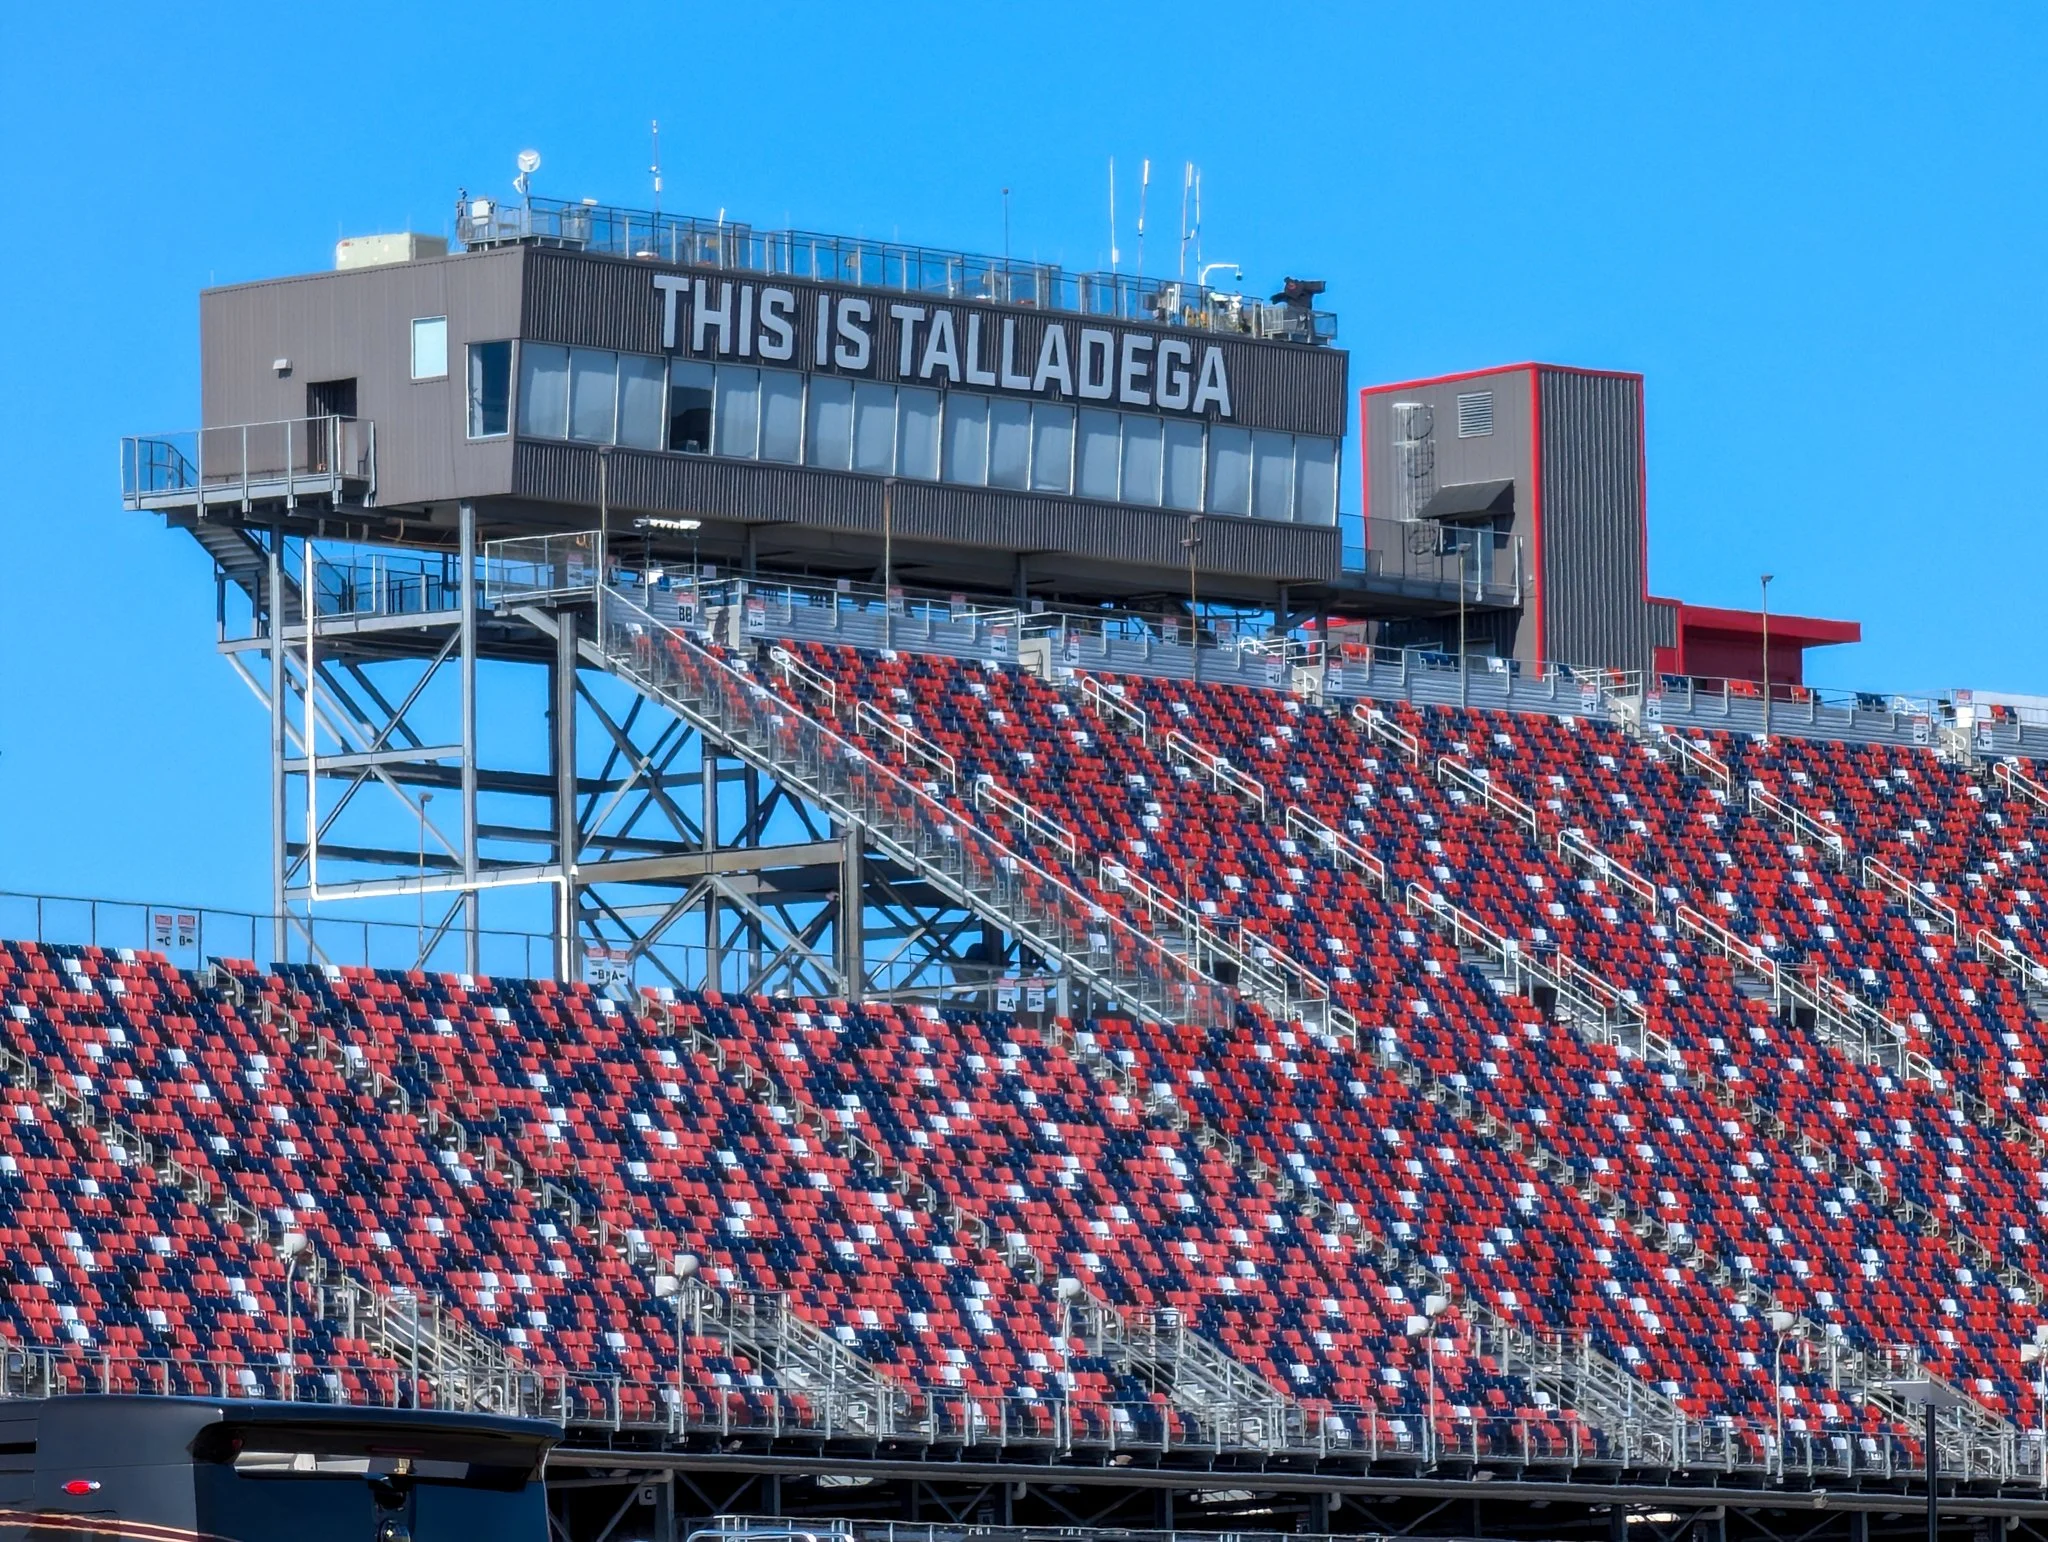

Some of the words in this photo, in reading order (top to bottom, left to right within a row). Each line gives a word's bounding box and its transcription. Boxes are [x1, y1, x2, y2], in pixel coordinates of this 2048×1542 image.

[653, 274, 794, 361] THIS
[816, 294, 871, 371] IS
[890, 304, 1232, 418] TALLADEGA
[678, 606, 692, 622] BB
[1589, 702, 1595, 712] T
[165, 936, 171, 946] C
[179, 935, 185, 946] B
[598, 969, 604, 980] B
[612, 970, 619, 980] A
[1007, 998, 1015, 1009] A
[644, 1489, 652, 1500] C
